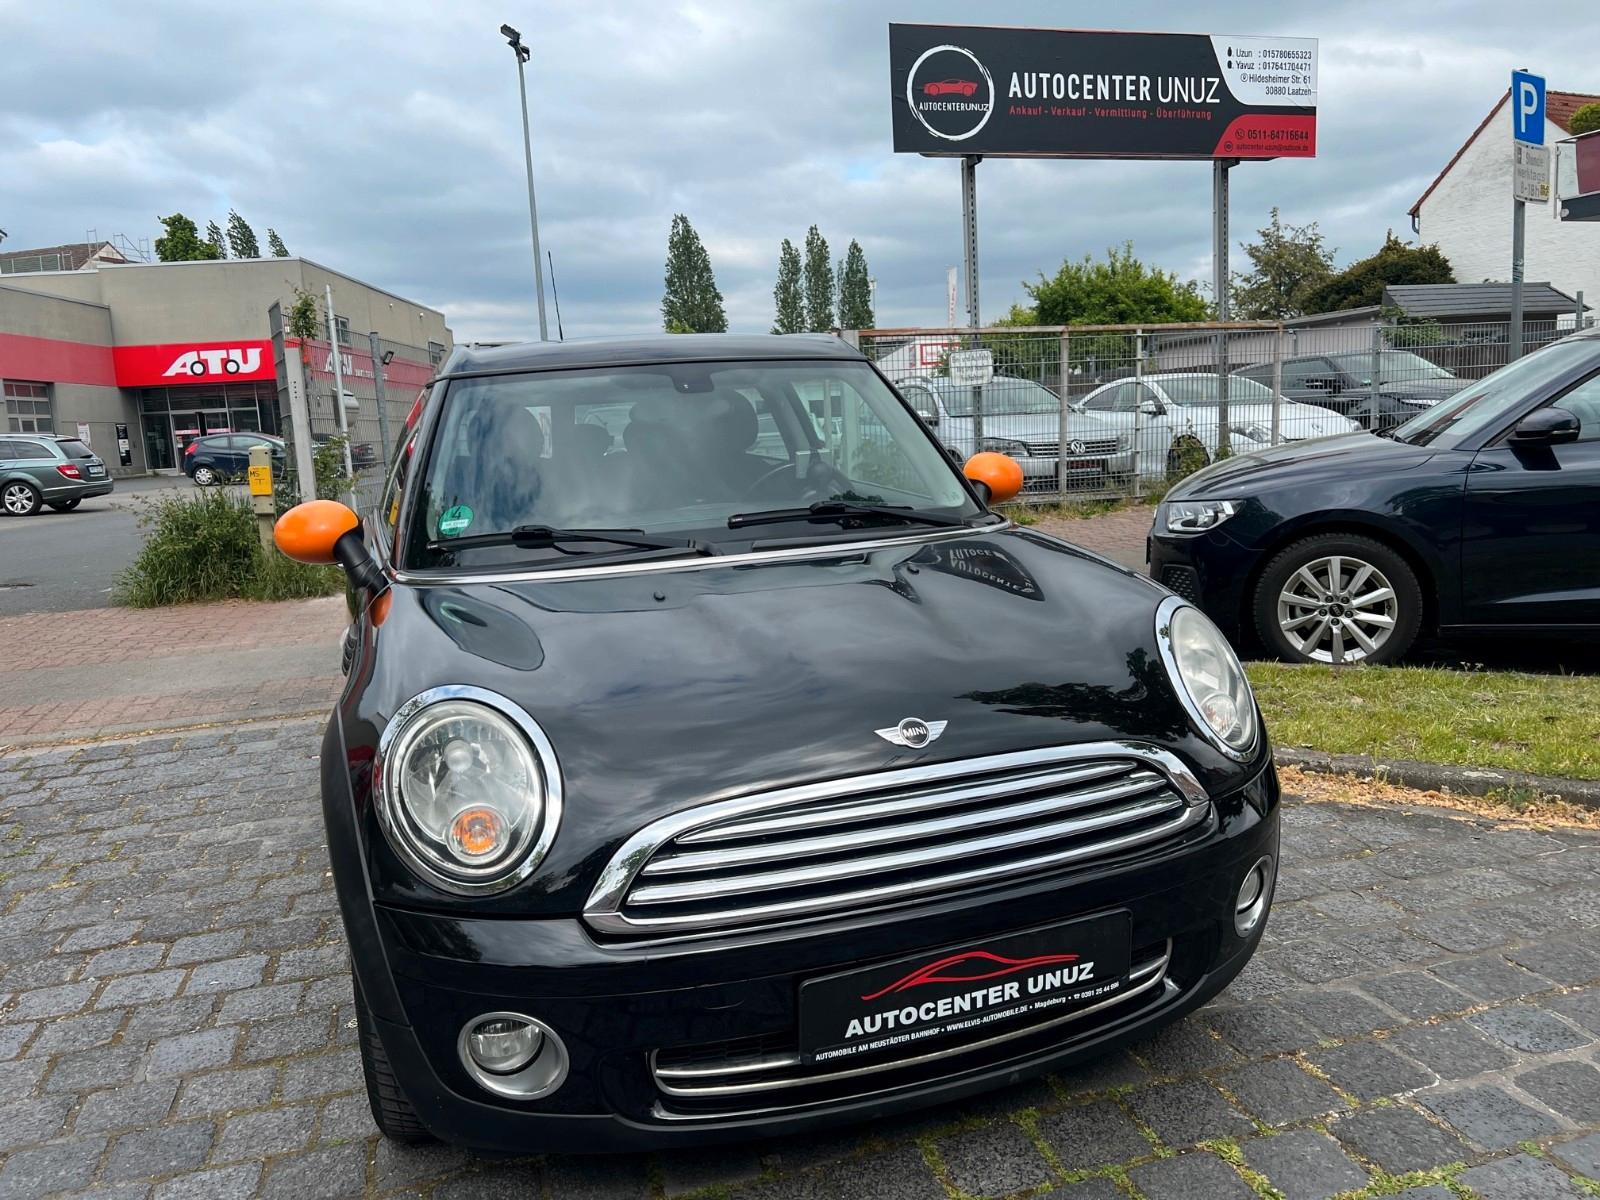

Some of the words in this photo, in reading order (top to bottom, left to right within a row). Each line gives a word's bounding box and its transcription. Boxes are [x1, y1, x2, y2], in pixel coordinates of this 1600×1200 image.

[1236, 48, 1252, 58] Uzun
[1236, 60, 1255, 70] Yavuz
[1248, 73, 1290, 84] Hildesheimer
[1291, 74, 1302, 84] Str.
[1008, 72, 1151, 101] AUTOCENTER
[1157, 76, 1220, 103] UNUZ
[1265, 86, 1287, 96] 30880
[1287, 86, 1312, 96] Laatzen
[1009, 105, 1042, 115] Ankauf
[1050, 106, 1087, 116] Verkauf
[1094, 107, 1147, 119] Vermittlung
[1156, 107, 1212, 120] Überführung
[1520, 81, 1538, 133] P
[161, 347, 263, 377] ATU
[902, 725, 927, 738] MINI
[844, 981, 1020, 1039] AUTOCENTER
[1027, 961, 1094, 994] UNUZ
[815, 1046, 857, 1061] AUTOMOBILE
[858, 1044, 869, 1052] AM
[911, 1027, 940, 1040] BAHNHOF
[1034, 996, 1066, 1009] Magdeburg
